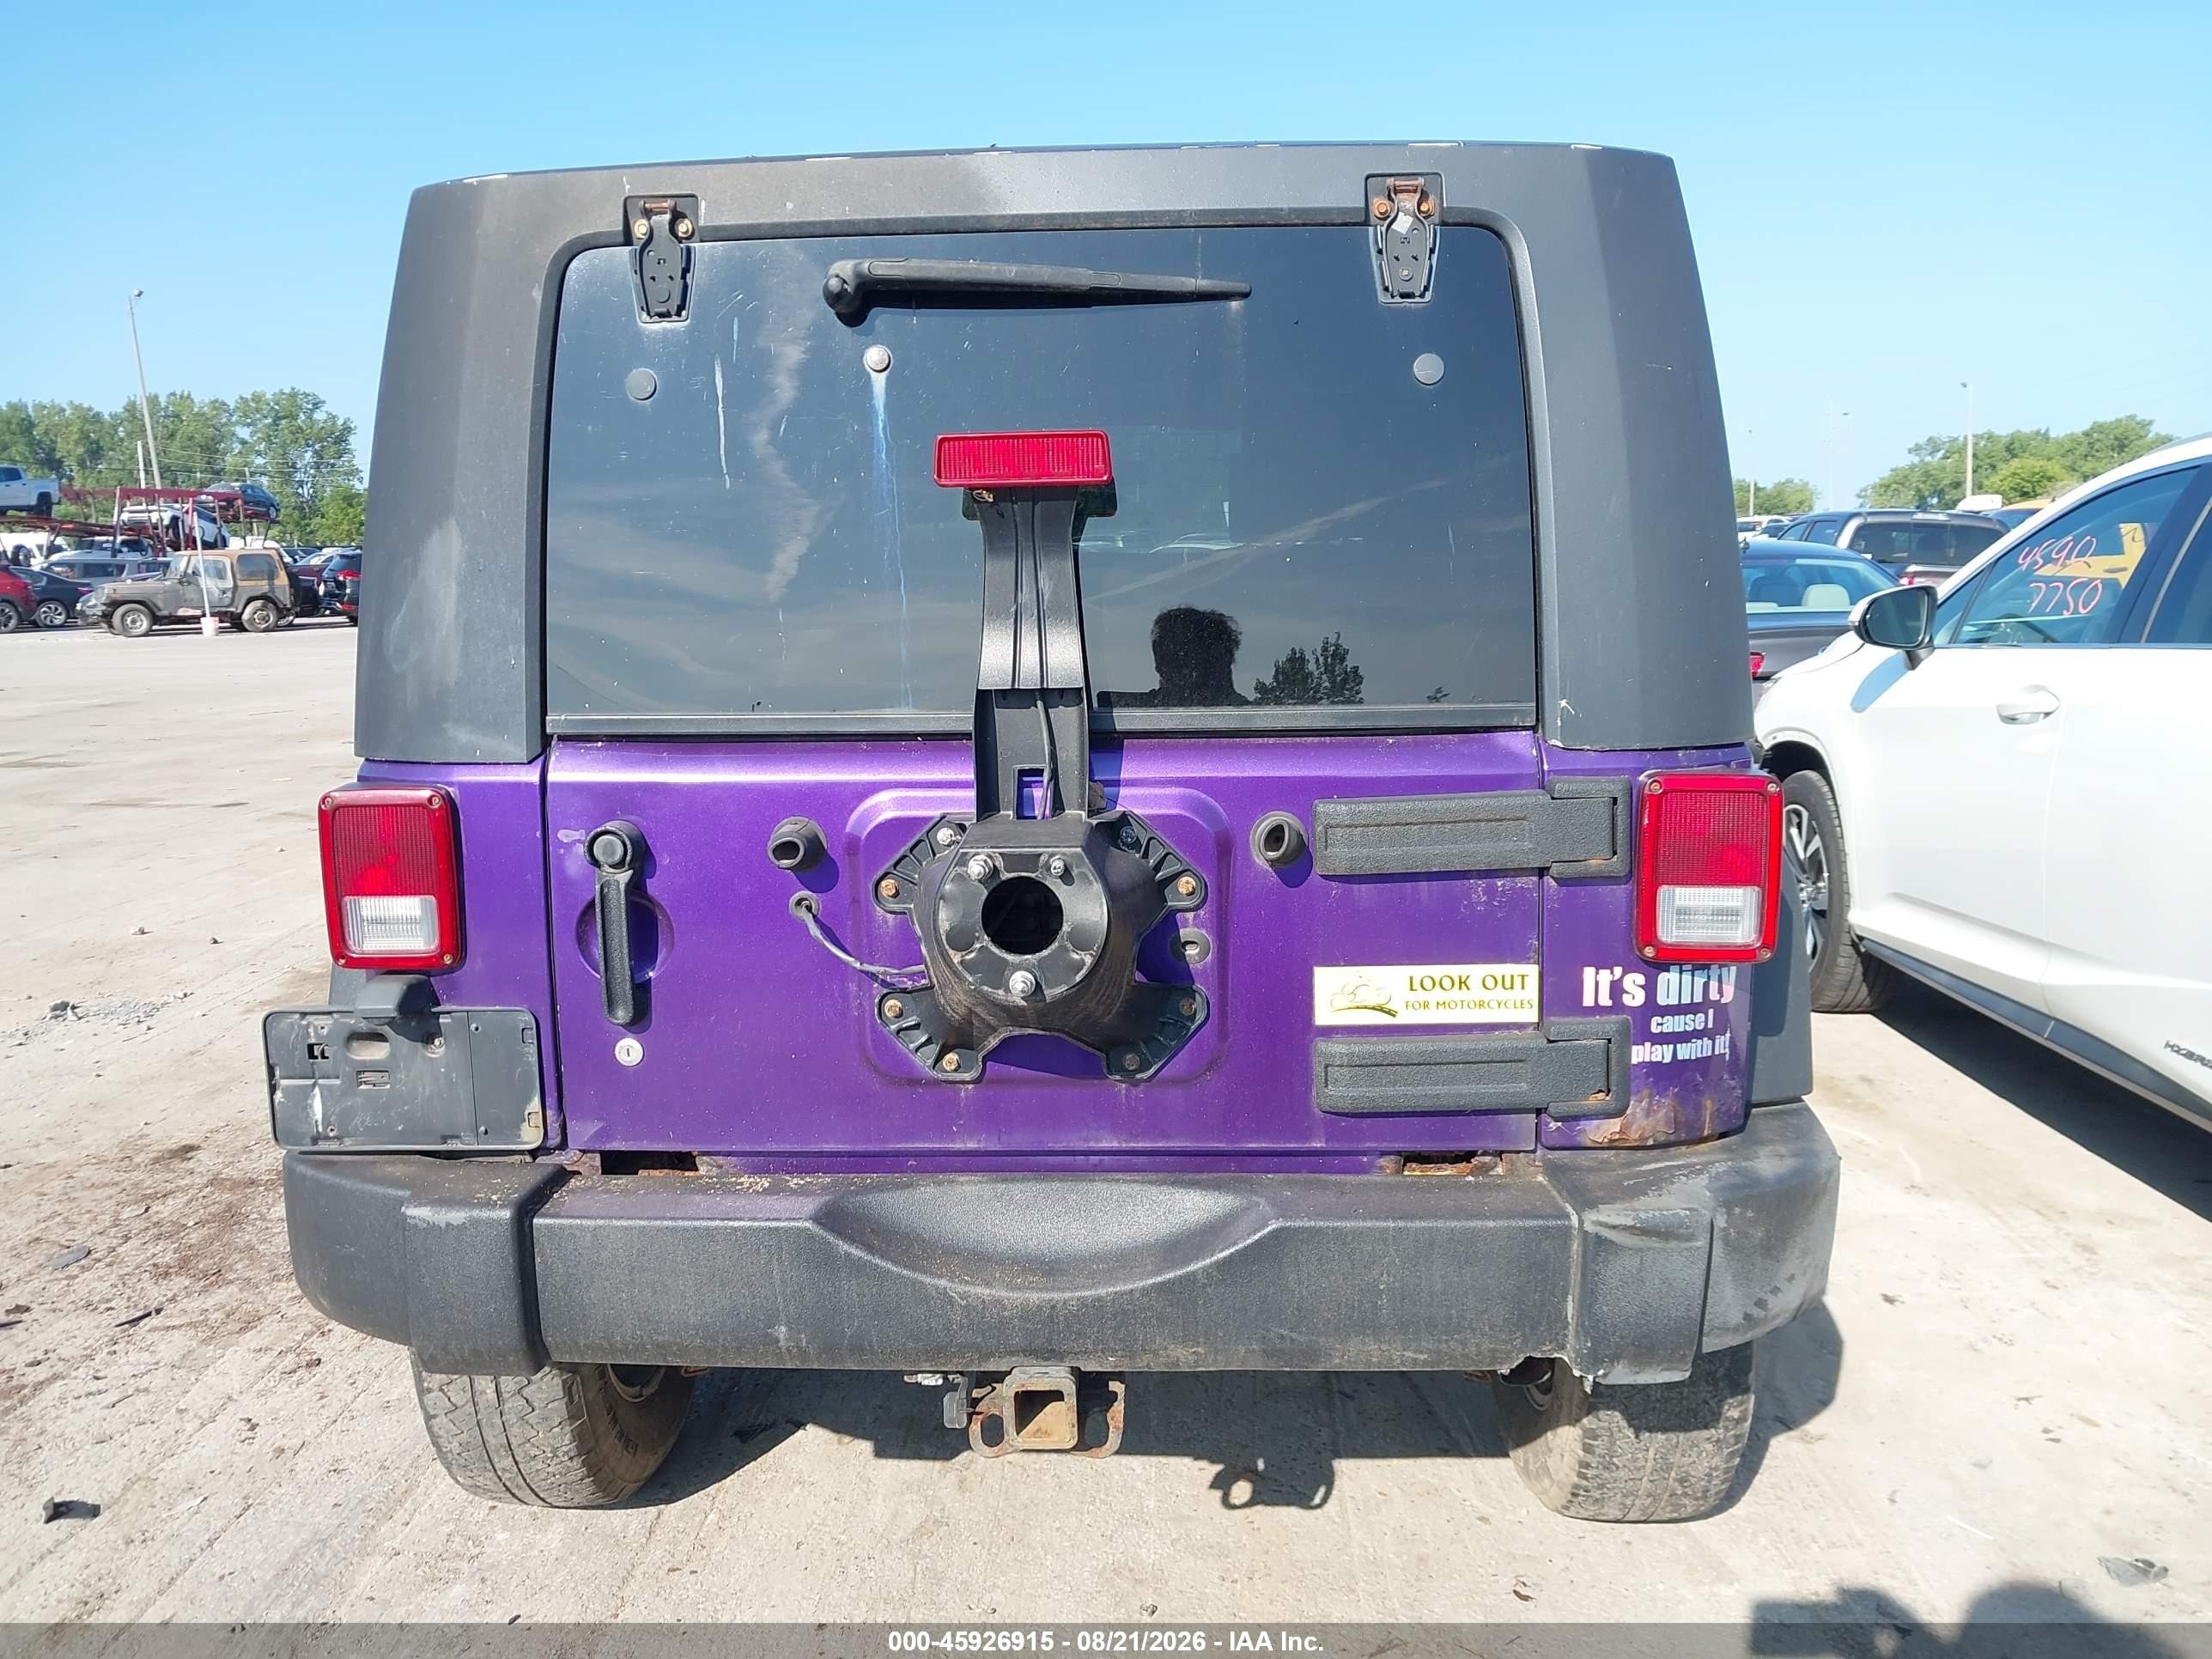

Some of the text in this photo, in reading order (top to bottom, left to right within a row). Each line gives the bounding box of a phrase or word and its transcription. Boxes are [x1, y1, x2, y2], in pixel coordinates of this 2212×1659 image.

[2028, 577, 2103, 616] 7750
[1408, 974, 1529, 992] LOOK OUT
[1582, 964, 1737, 1007] It's dirty
[1405, 999, 1534, 1011] FOR MOTORCYCLES
[1650, 1008, 1715, 1034] cause I
[1631, 1041, 1674, 1065] play
[1676, 1036, 1713, 1060] with
